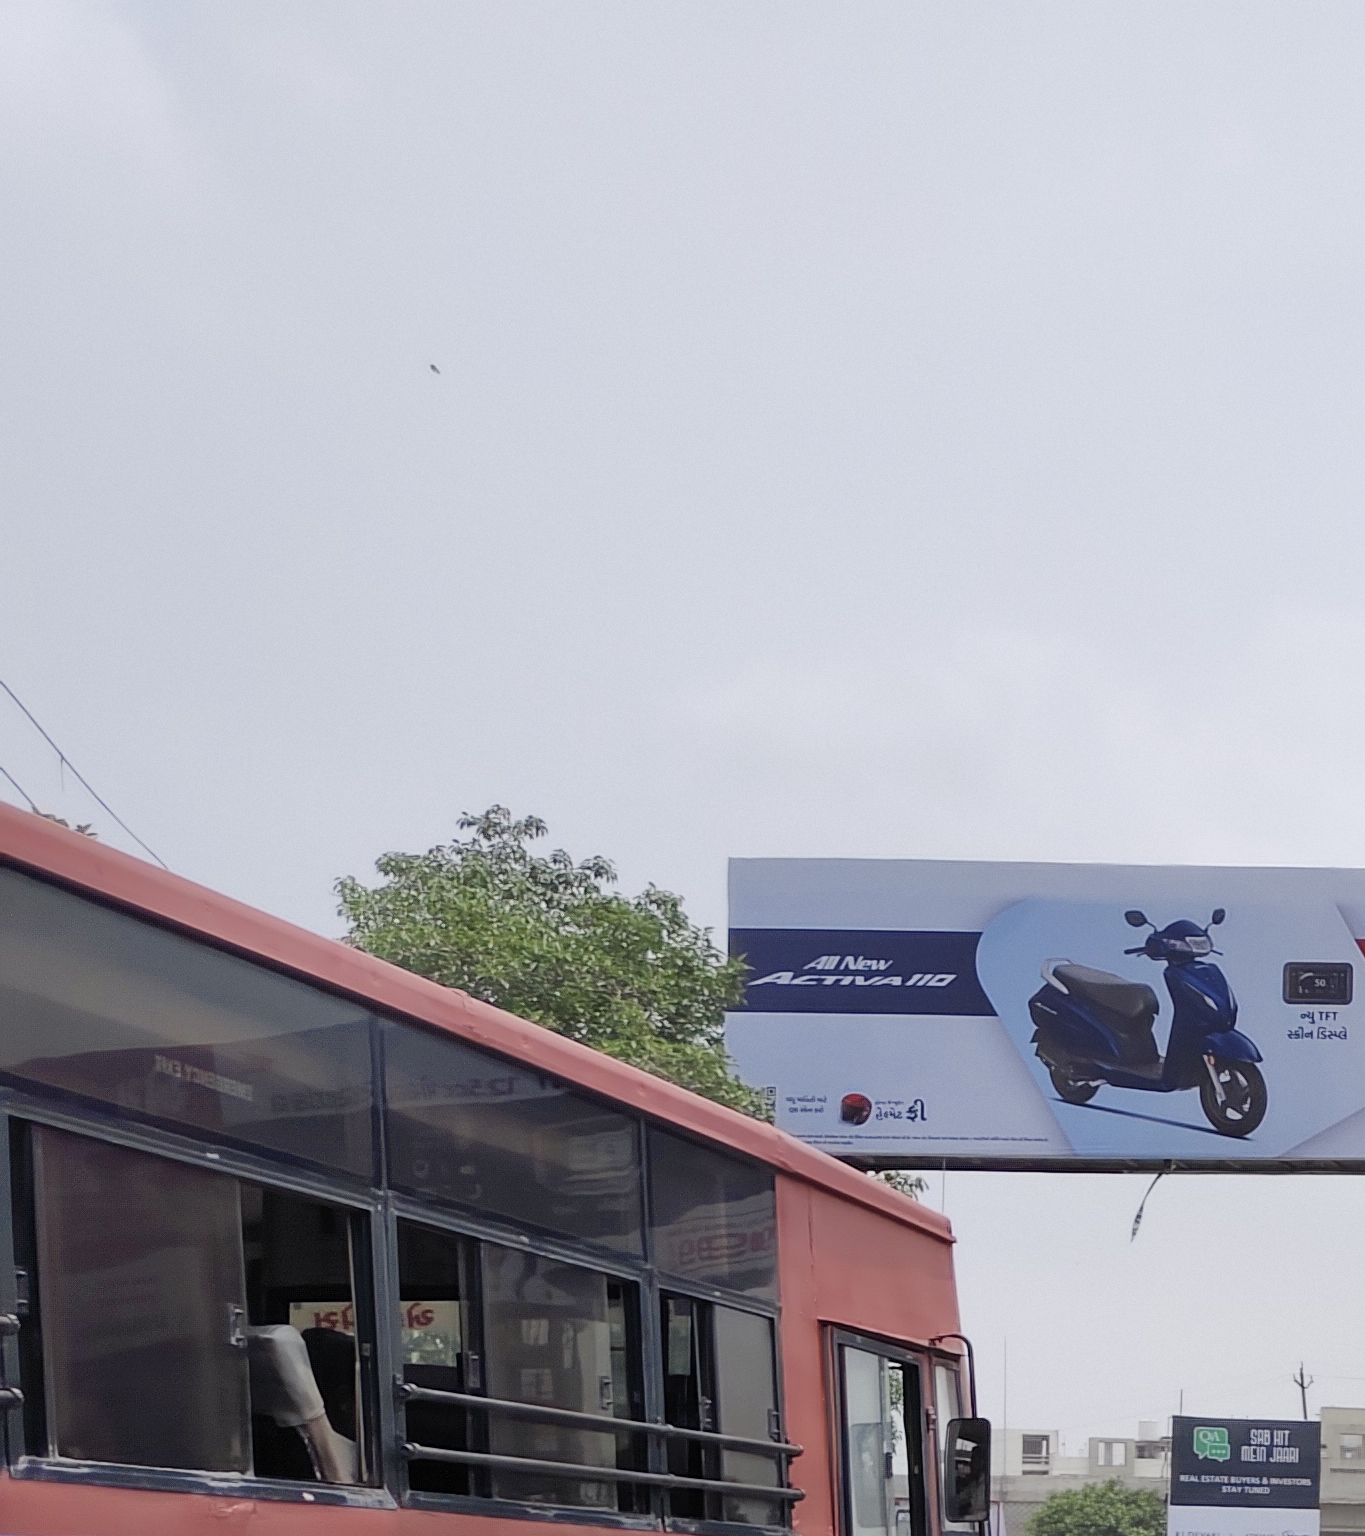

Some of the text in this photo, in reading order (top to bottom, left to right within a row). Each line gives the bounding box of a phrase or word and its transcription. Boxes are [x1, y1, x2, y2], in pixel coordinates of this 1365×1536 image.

[839, 955, 894, 971] New
[1318, 1011, 1338, 1021] TFT
[1250, 1429, 1271, 1445] SAB
[1179, 1474, 1199, 1482] REAL
[1201, 1475, 1229, 1484] ESTATE
[1230, 1476, 1261, 1484] BUYERS
[1269, 1478, 1312, 1486] INVESTORS
[1221, 1485, 1270, 1494] STAY TUNED
